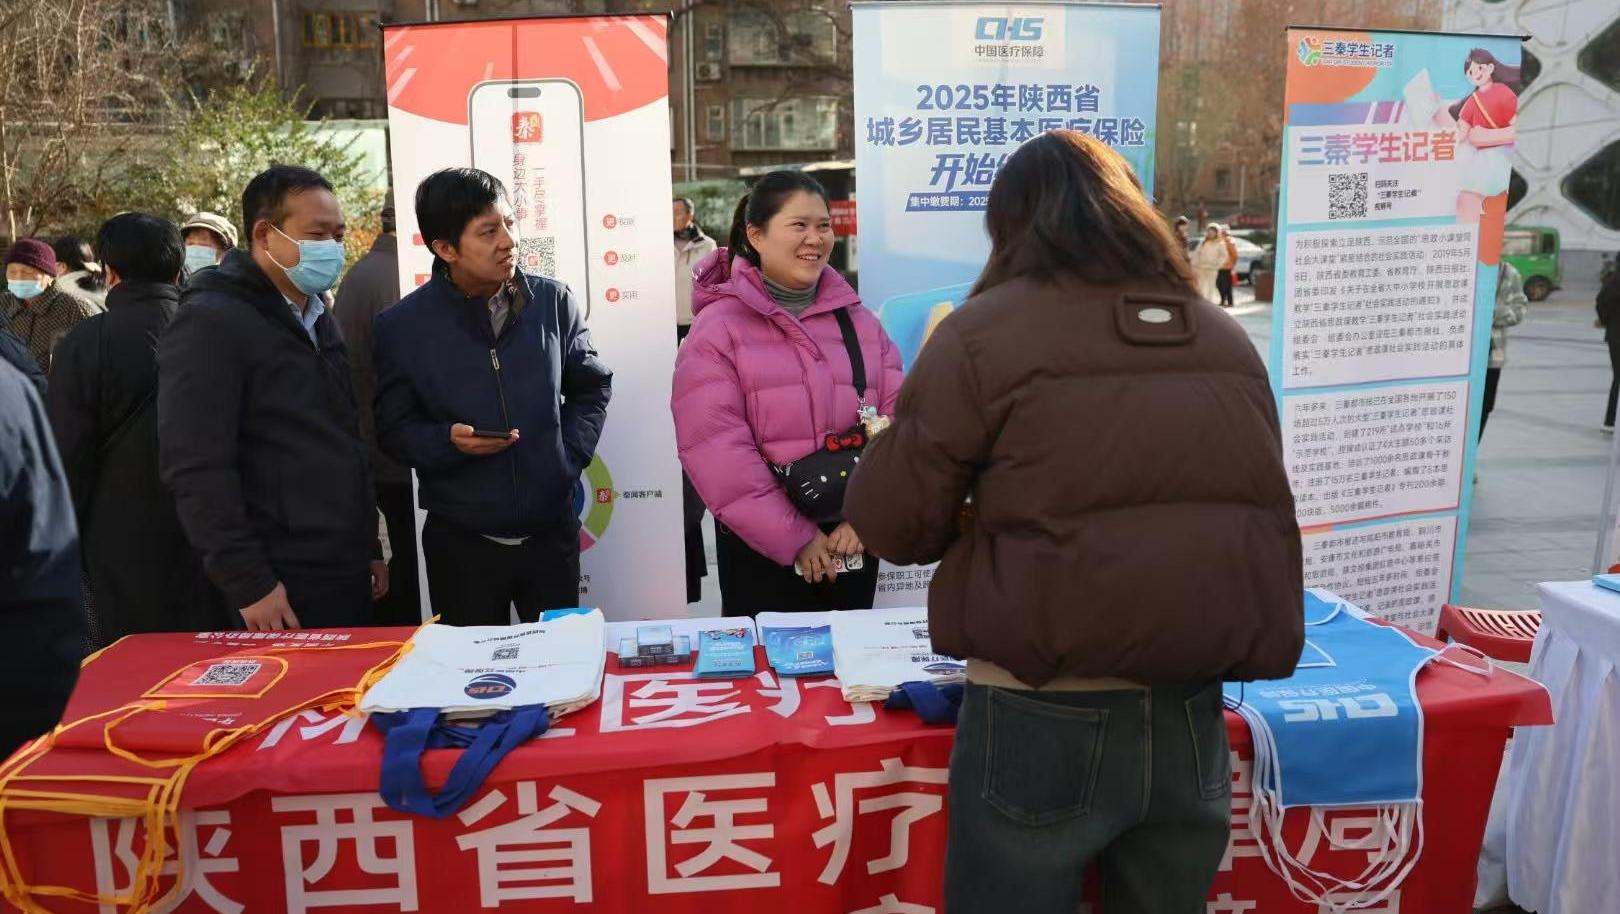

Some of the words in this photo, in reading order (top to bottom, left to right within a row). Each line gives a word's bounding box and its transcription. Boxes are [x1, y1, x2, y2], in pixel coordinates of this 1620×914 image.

[975, 16, 1045, 41] CHS
[974, 45, 1044, 58] 中国医疗保障
[1322, 42, 1394, 58] 三秦学生记者
[916, 84, 1101, 113] 2025年陕西省
[1298, 130, 1457, 166] 三秦学生记者
[929, 153, 1003, 193] 开始
